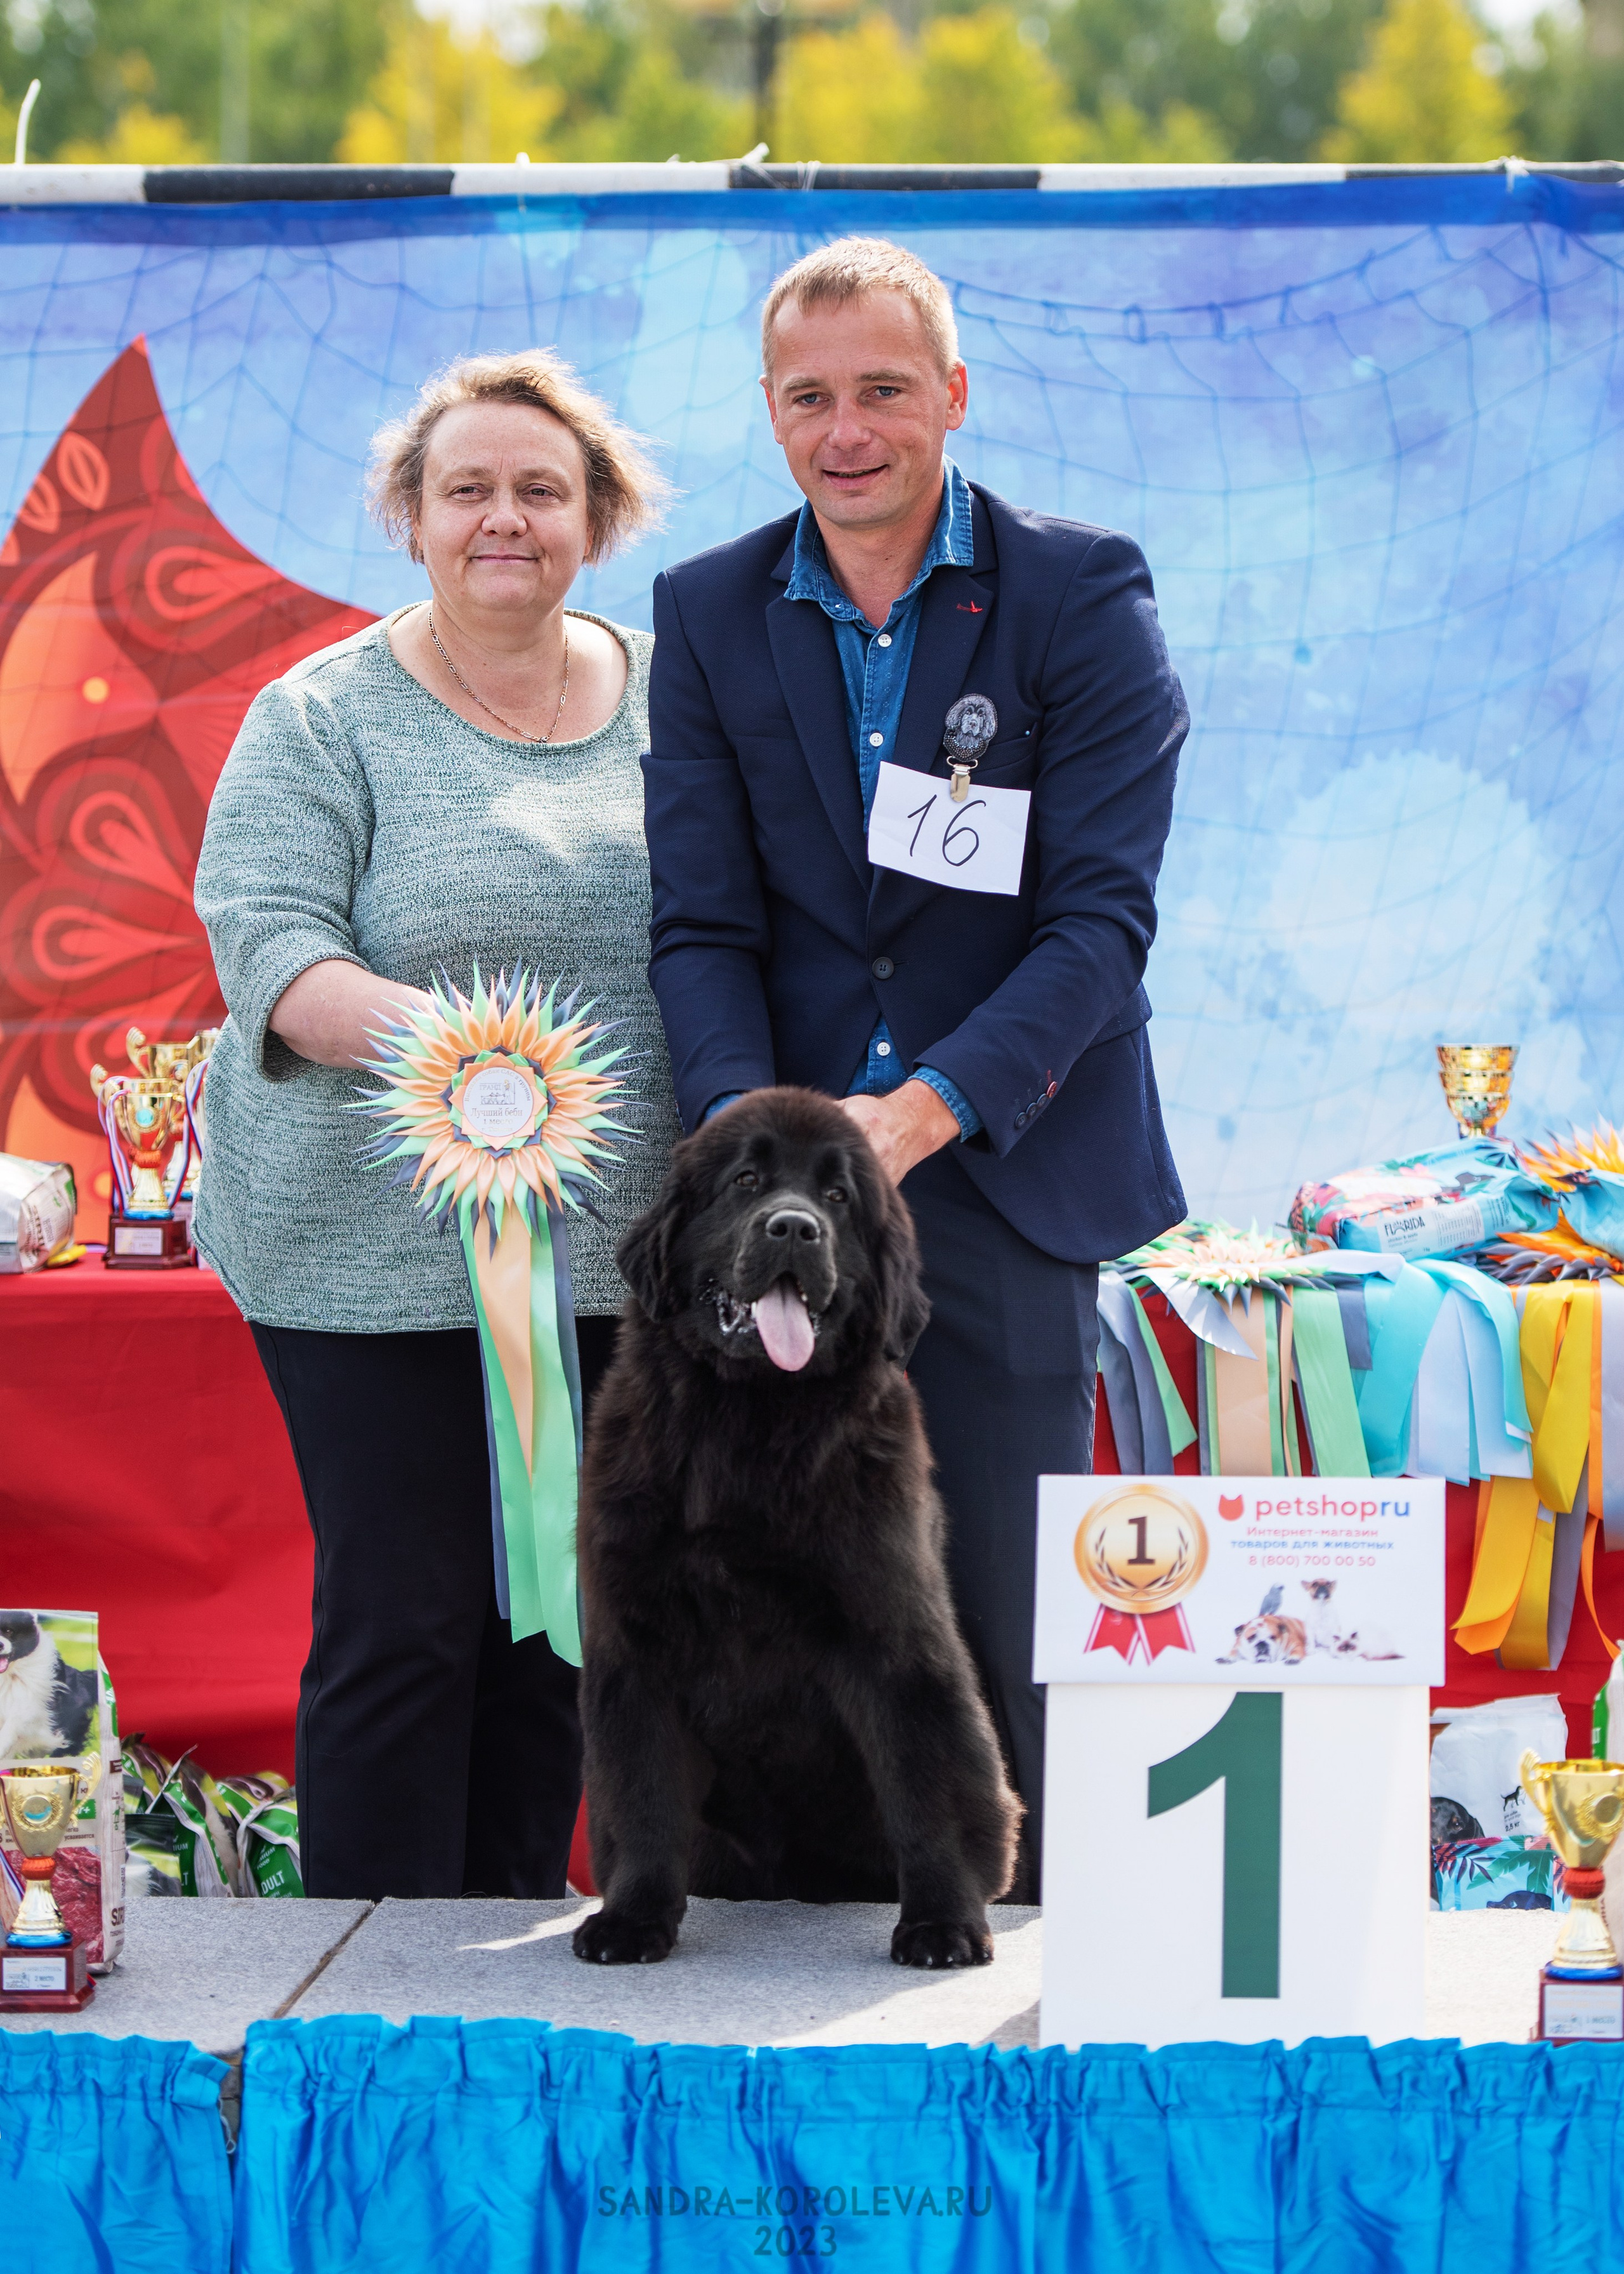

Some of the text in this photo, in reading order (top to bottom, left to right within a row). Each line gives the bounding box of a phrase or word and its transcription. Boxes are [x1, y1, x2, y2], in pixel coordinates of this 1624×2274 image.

[907, 794, 986, 867] 16
[470, 1107, 523, 1119] Лучший беби
[1384, 1214, 1426, 1237] FLORIDA
[1127, 1516, 1155, 1565] 1
[1247, 1527, 1378, 1538] Интернет-магазин
[1231, 1540, 1394, 1550] товаров для животных
[1248, 1554, 1376, 1568] 8 (800) 700 00 50
[1505, 1823, 1514, 1832] 2,5
[1147, 1692, 1284, 1999] 1
[261, 1869, 285, 1896] DULT
